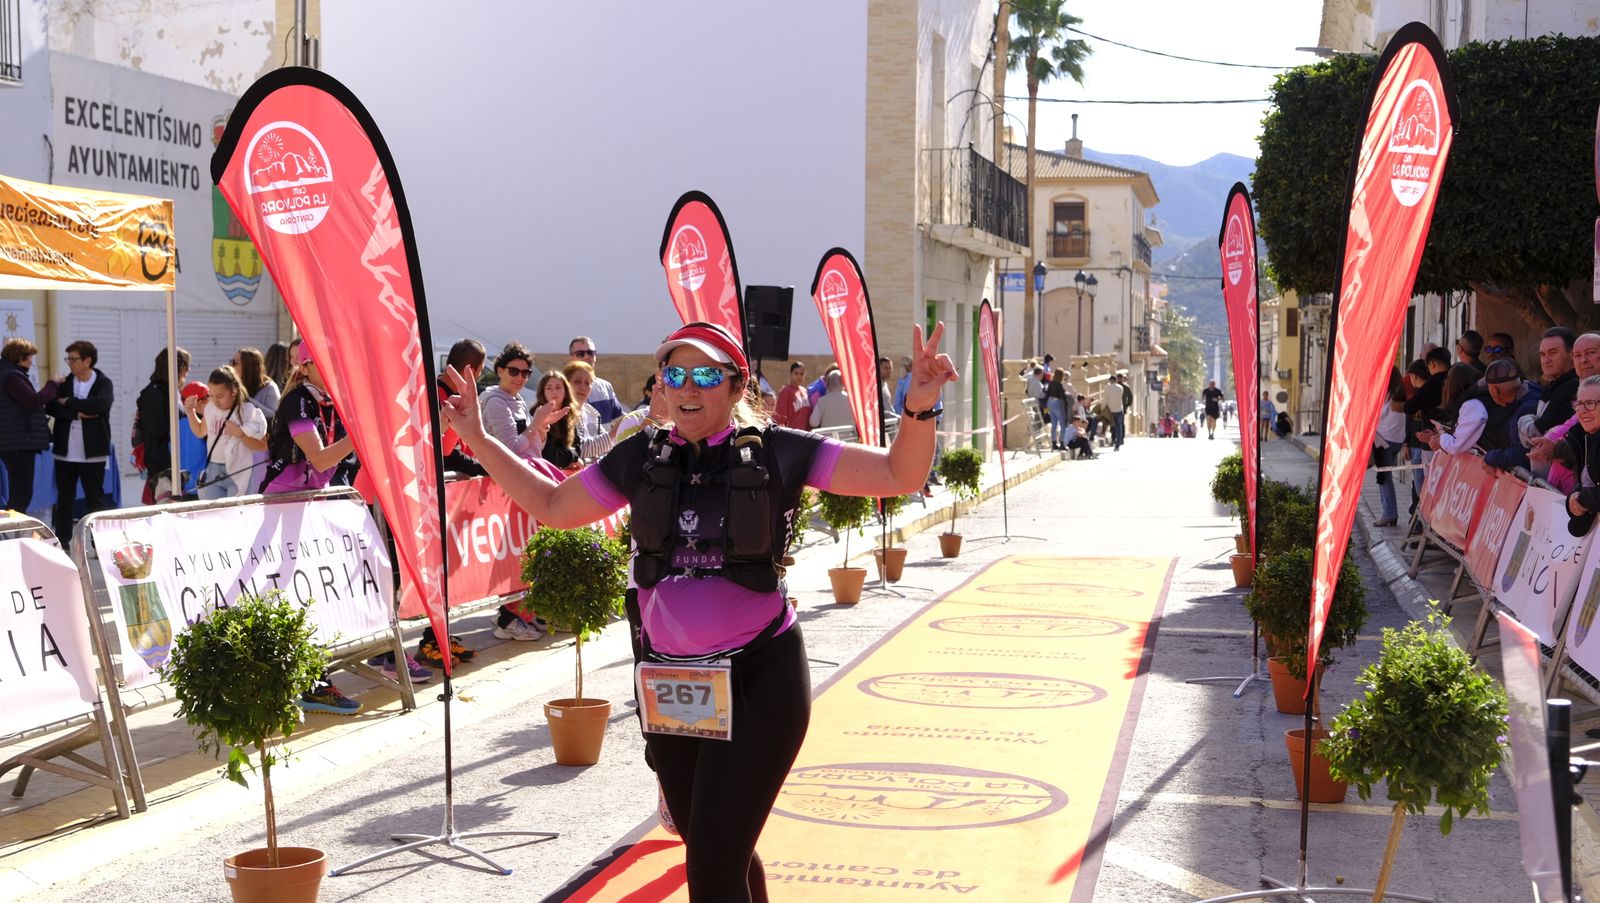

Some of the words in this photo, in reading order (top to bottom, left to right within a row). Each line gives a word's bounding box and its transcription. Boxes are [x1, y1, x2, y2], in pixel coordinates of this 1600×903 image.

[65, 96, 202, 149] EXCELENTÍSIMO
[68, 145, 200, 191] AYUNTAMIENTO
[450, 511, 539, 567] VEOLIA
[174, 537, 335, 577] AYUNTAMIENTO
[343, 533, 368, 552] DE
[11, 586, 46, 614] DE
[181, 559, 380, 625] CANTORIA
[0, 622, 68, 682] IA
[655, 683, 712, 706] 267
[842, 730, 1049, 745] Ayuntamiento
[797, 772, 970, 787] POLVORA
[985, 782, 1030, 790] LA
[762, 860, 899, 876] Cantor
[912, 869, 961, 879] de
[764, 873, 980, 894] Ayuntamie
